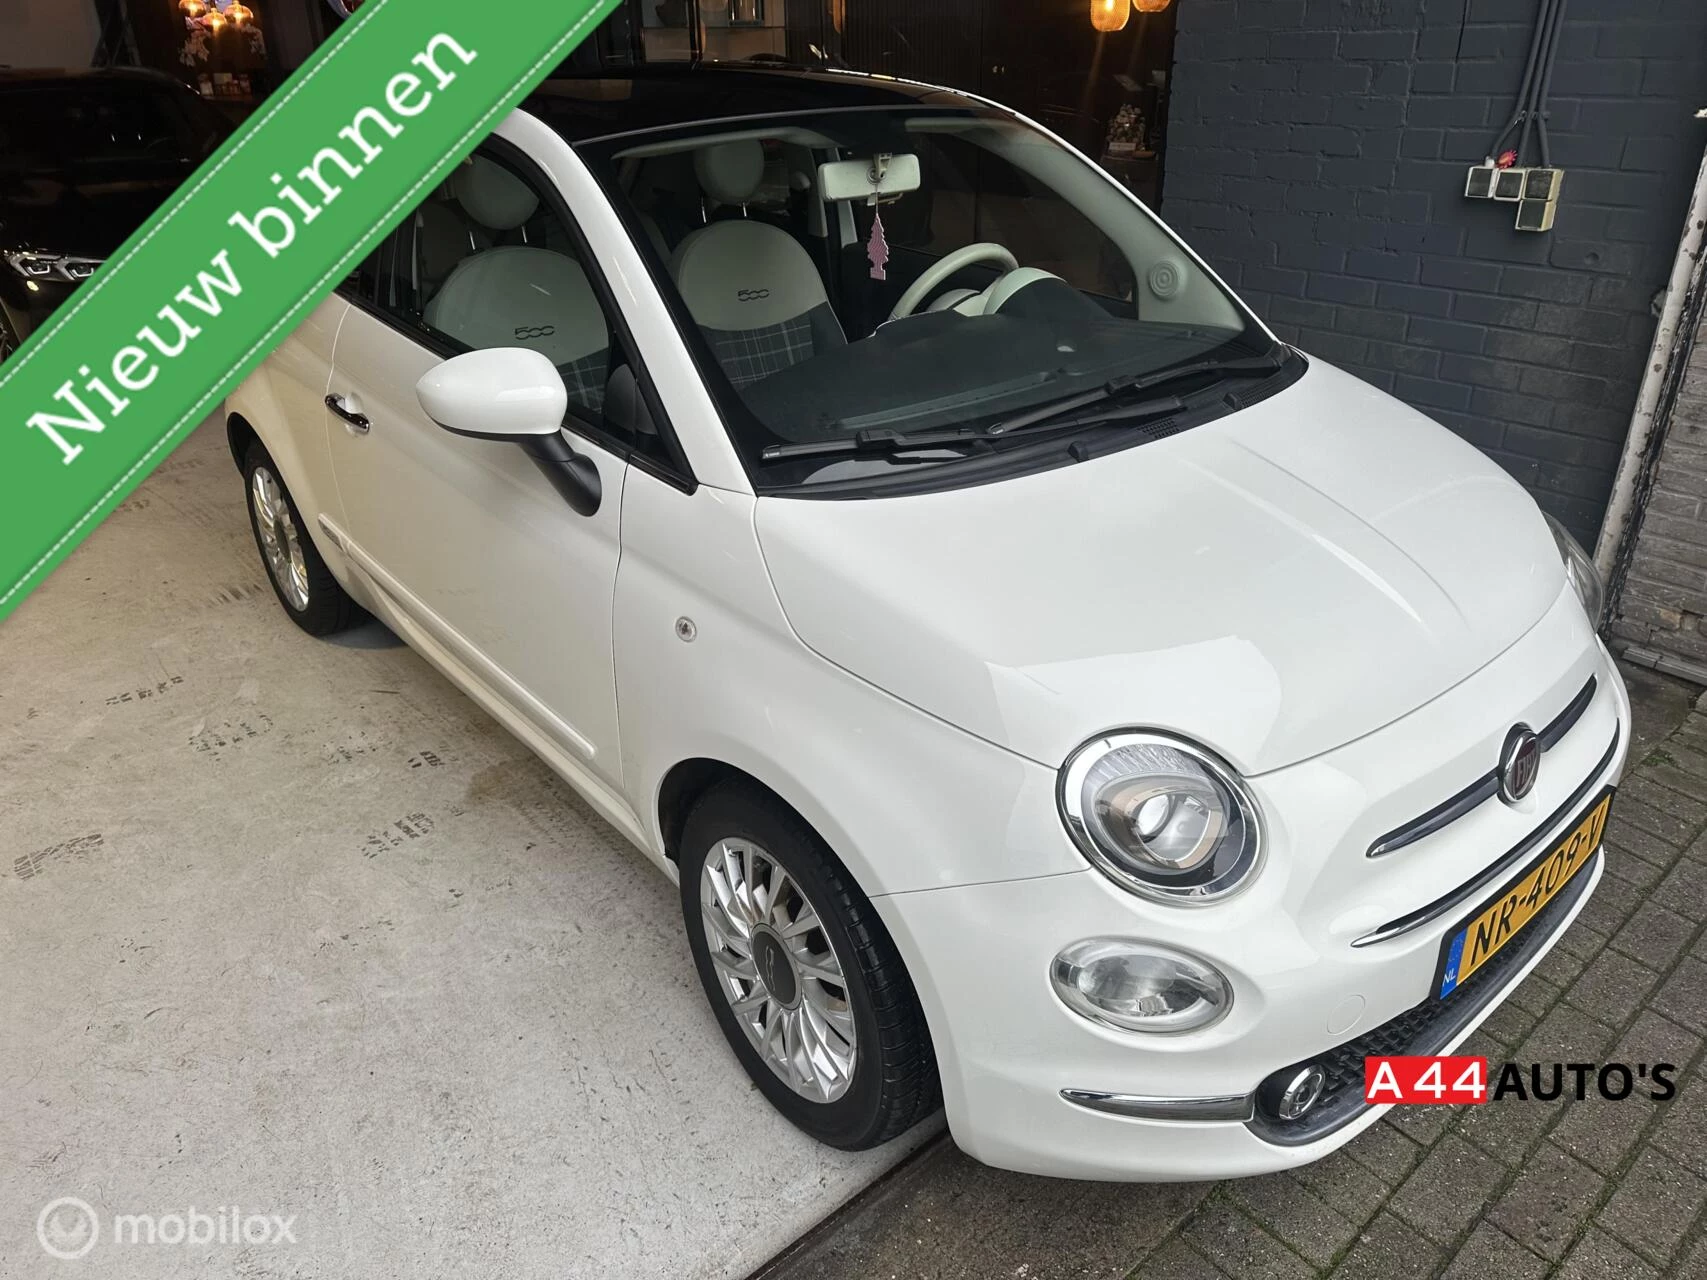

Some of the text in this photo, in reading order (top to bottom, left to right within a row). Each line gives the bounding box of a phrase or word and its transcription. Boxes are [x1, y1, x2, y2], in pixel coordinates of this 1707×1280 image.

[737, 288, 770, 302] 500
[514, 325, 555, 341] 500
[1470, 803, 1606, 967] NR-409-V
[1442, 967, 1457, 987] NL
